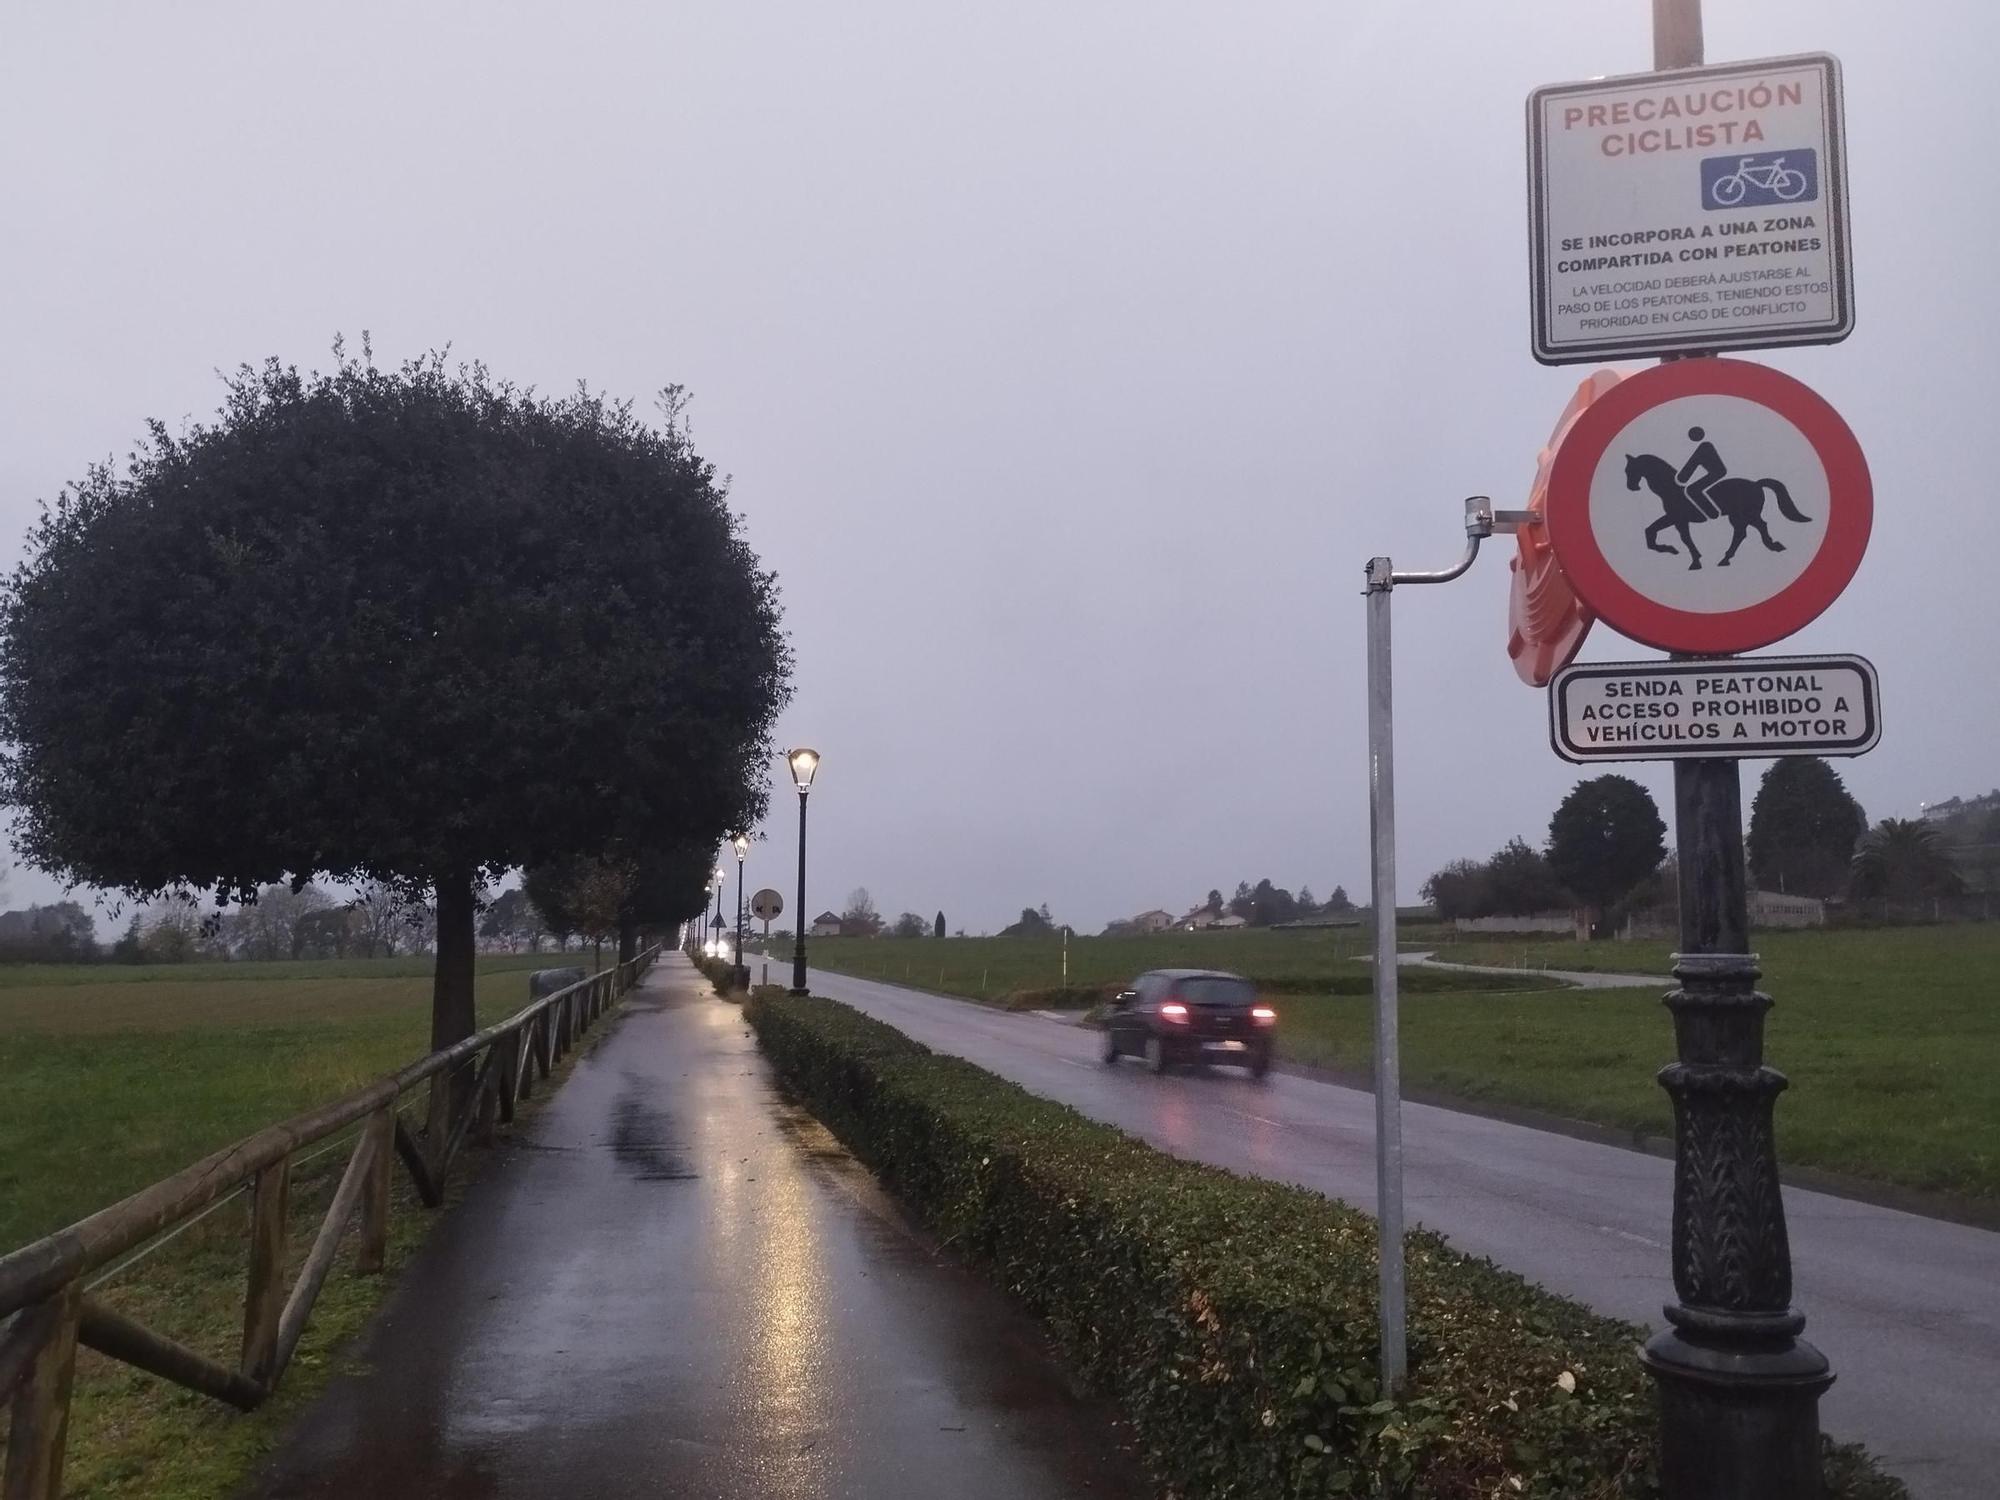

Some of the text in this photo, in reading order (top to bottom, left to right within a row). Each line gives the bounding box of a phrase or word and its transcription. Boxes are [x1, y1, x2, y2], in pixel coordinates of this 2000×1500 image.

[1564, 82, 1802, 130] PRECAUCIÓN
[1601, 120, 1765, 157] CICLISTA
[1561, 216, 1815, 251] SE INCORPORA A UNA ZONA
[1558, 238, 1821, 273] COMPARTIDA CON PEATONES
[1572, 268, 1811, 297] LA VELOCIDAD DEBERÁ AJUSTARSE AL
[1558, 282, 1828, 314] PASO DE LOS PEATONES, TENIENDO ESTOS
[1580, 301, 1806, 329] PRIORIDAD EN CASO DE CONFLICTO
[1605, 675, 1823, 697] SENDA PEATONAL
[1582, 696, 1849, 720] ACCESO PROHIBIDO A
[1587, 719, 1847, 741] VEHÍCULOS A MOTOR
